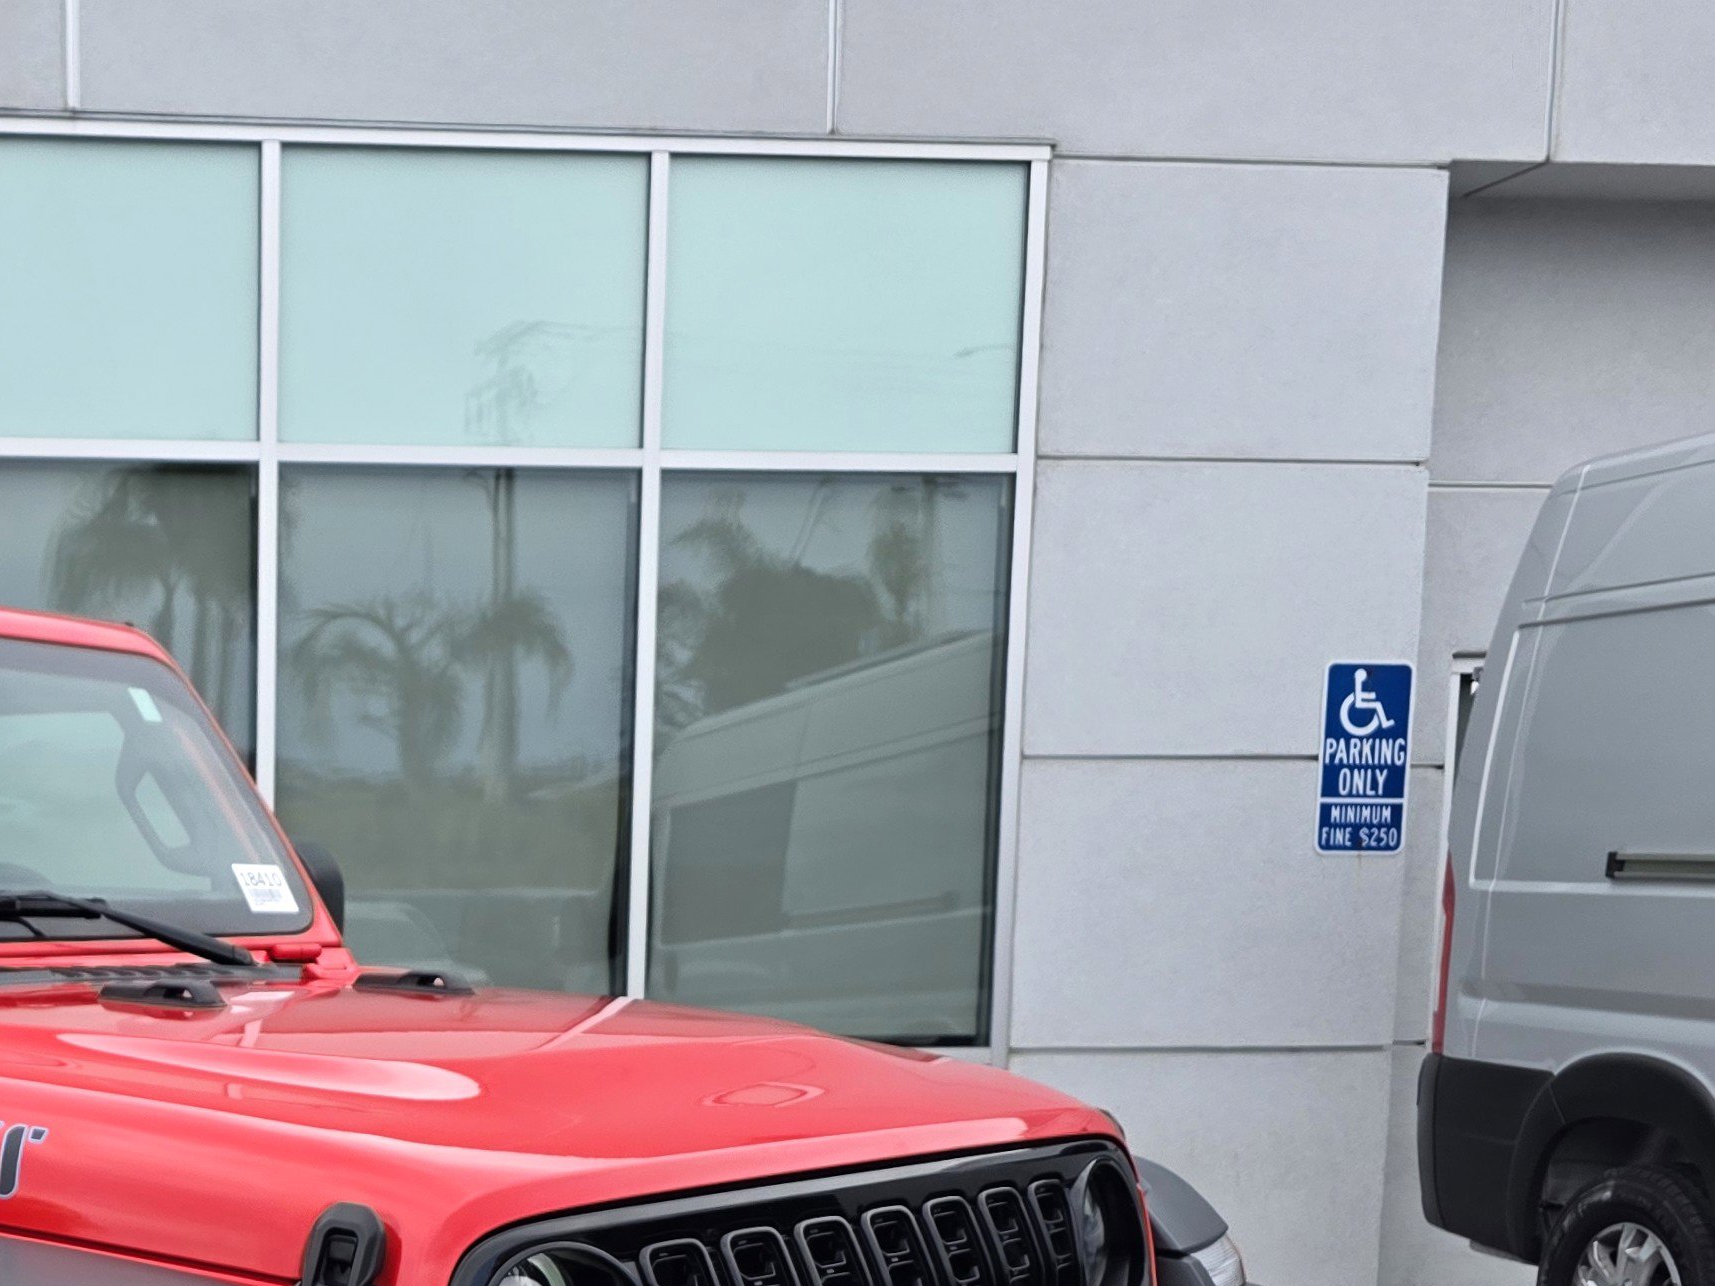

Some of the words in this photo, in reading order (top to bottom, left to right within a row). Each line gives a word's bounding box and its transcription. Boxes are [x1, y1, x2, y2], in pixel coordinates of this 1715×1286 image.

[1325, 738, 1406, 766] PARKING
[1338, 768, 1388, 796] ONLY
[1330, 805, 1391, 825] MINIMUM
[1321, 827, 1352, 847] FINE
[1360, 827, 1398, 847] $250
[240, 872, 282, 887] 18410
